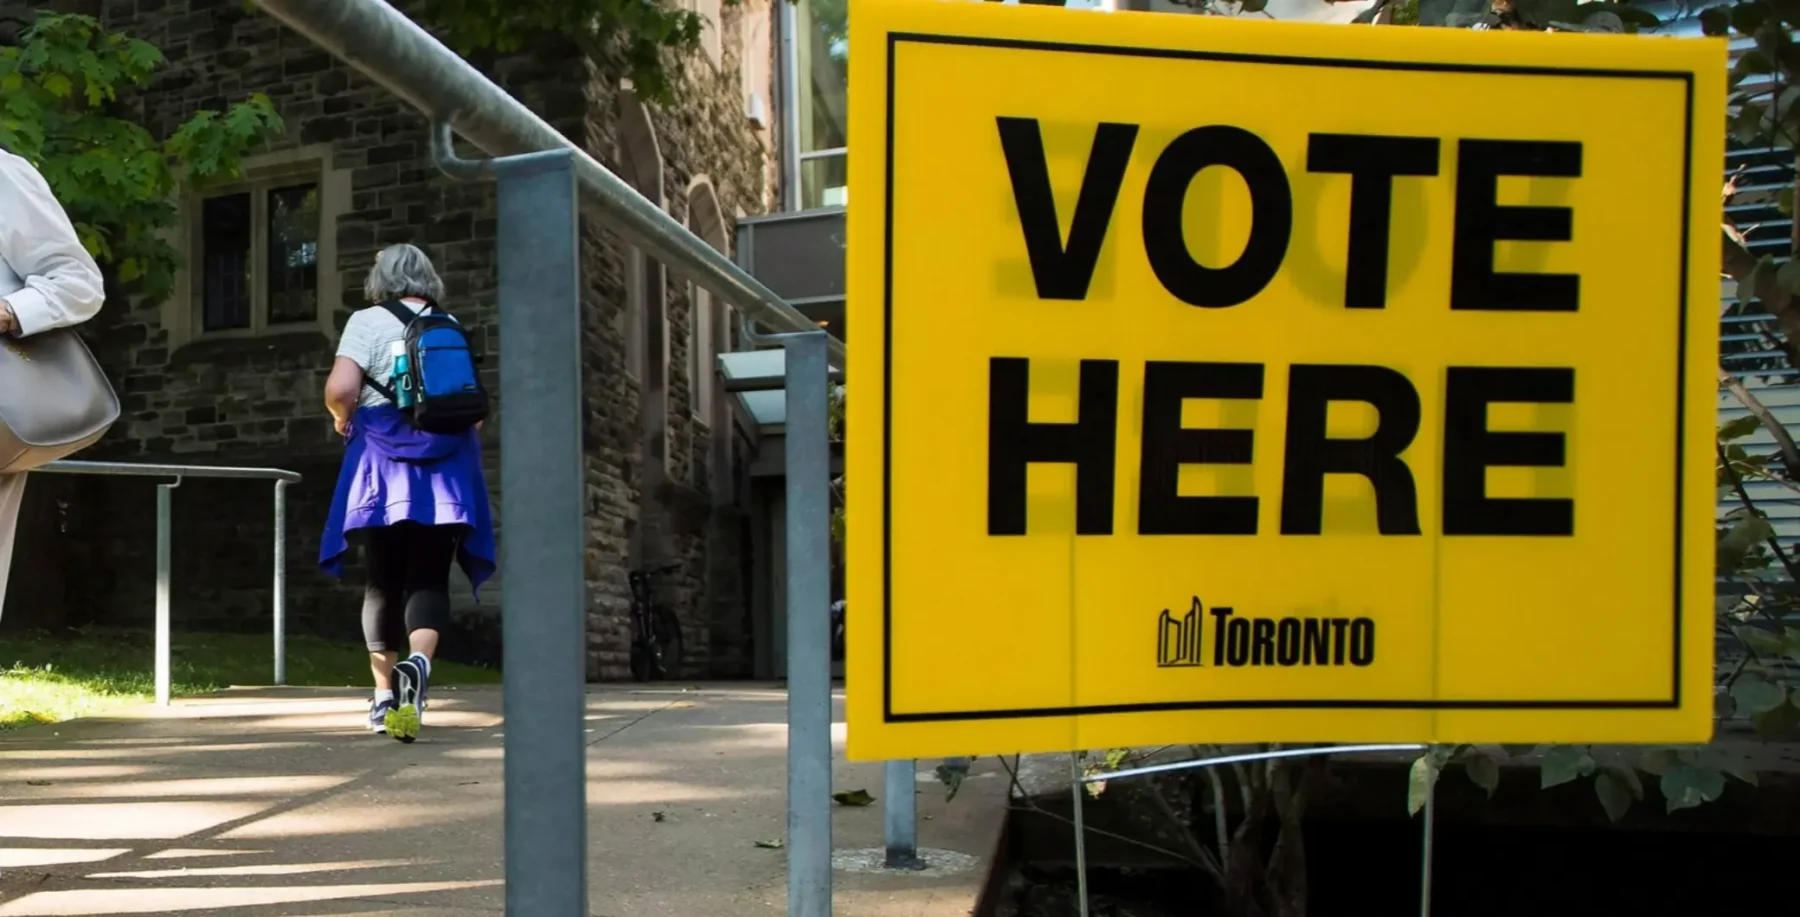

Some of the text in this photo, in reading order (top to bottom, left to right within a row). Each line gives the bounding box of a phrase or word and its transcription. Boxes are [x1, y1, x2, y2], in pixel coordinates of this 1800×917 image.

[997, 117, 1583, 312] VOTE
[988, 357, 1576, 537] HERE
[1210, 607, 1375, 667] TORONTO
